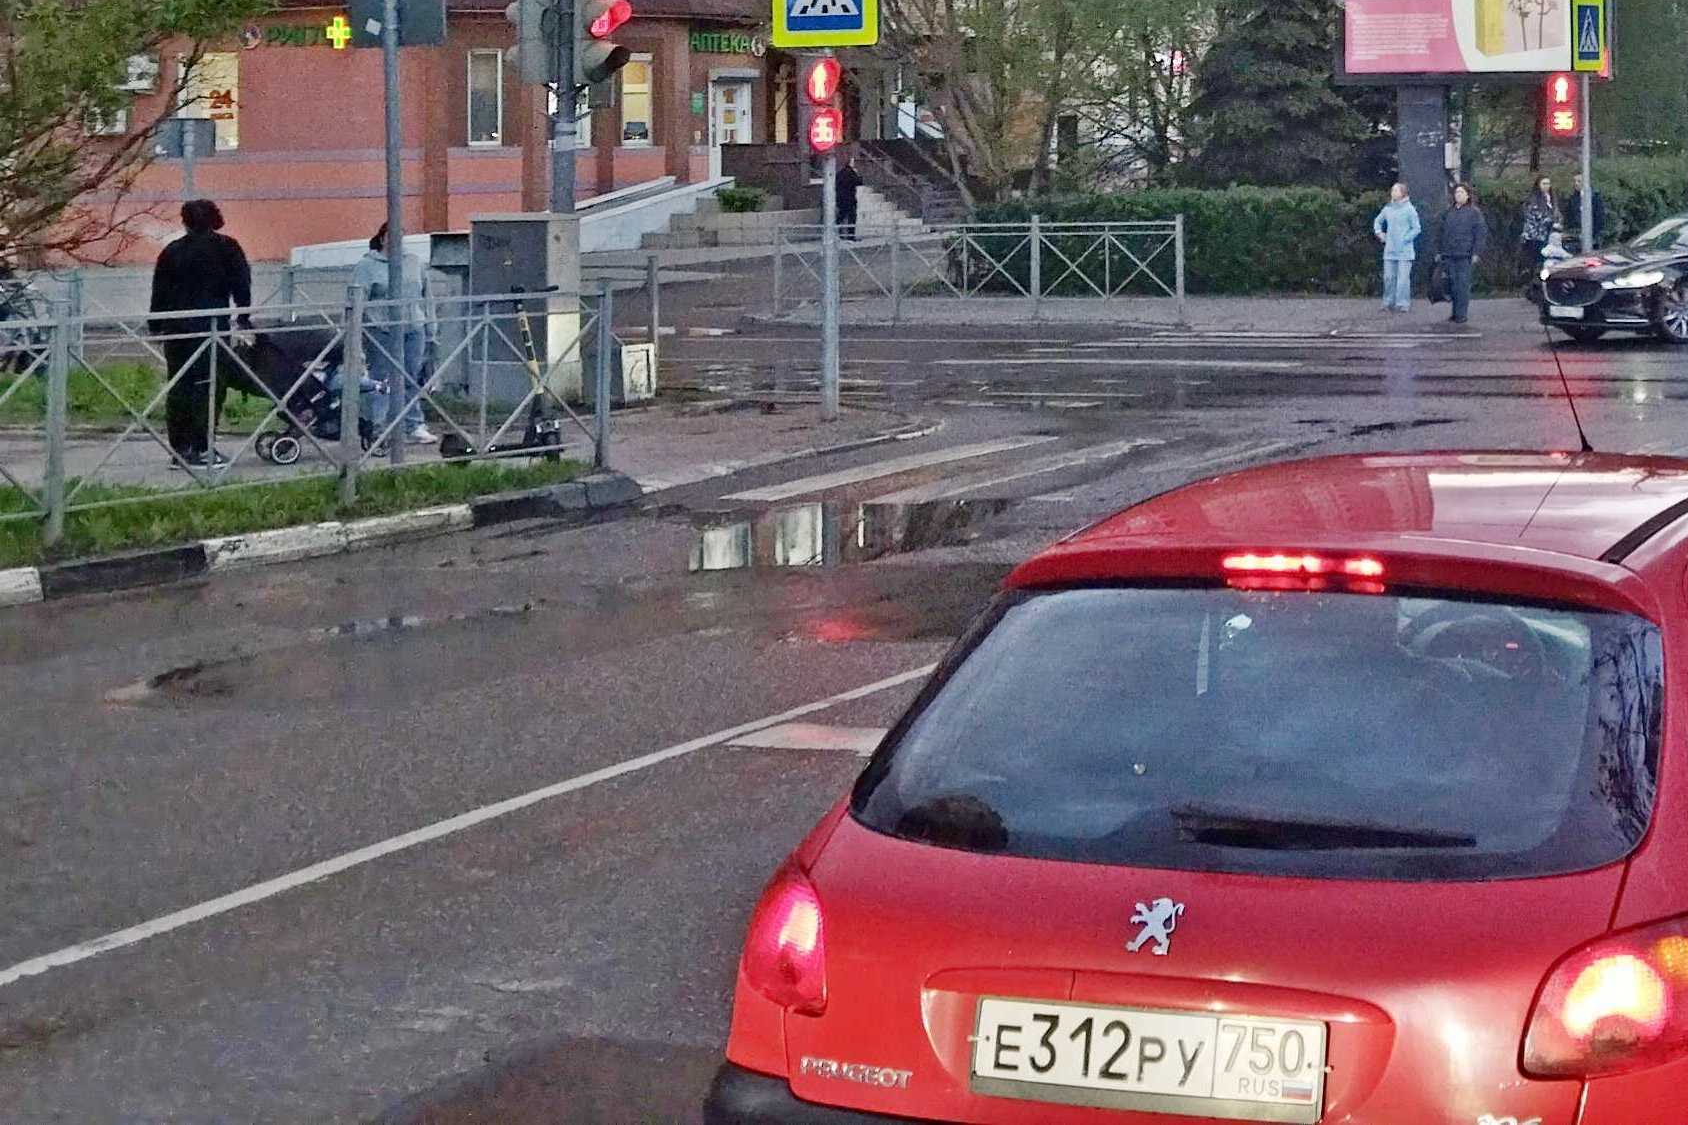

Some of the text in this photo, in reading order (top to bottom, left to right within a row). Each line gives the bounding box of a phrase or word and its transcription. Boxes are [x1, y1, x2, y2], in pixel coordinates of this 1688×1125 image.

[691, 33, 750, 52] АПТЕКА
[1222, 1024, 1305, 1078] 750
[800, 1055, 913, 1089] PEUGEOT
[1238, 1076, 1281, 1096] RUS
